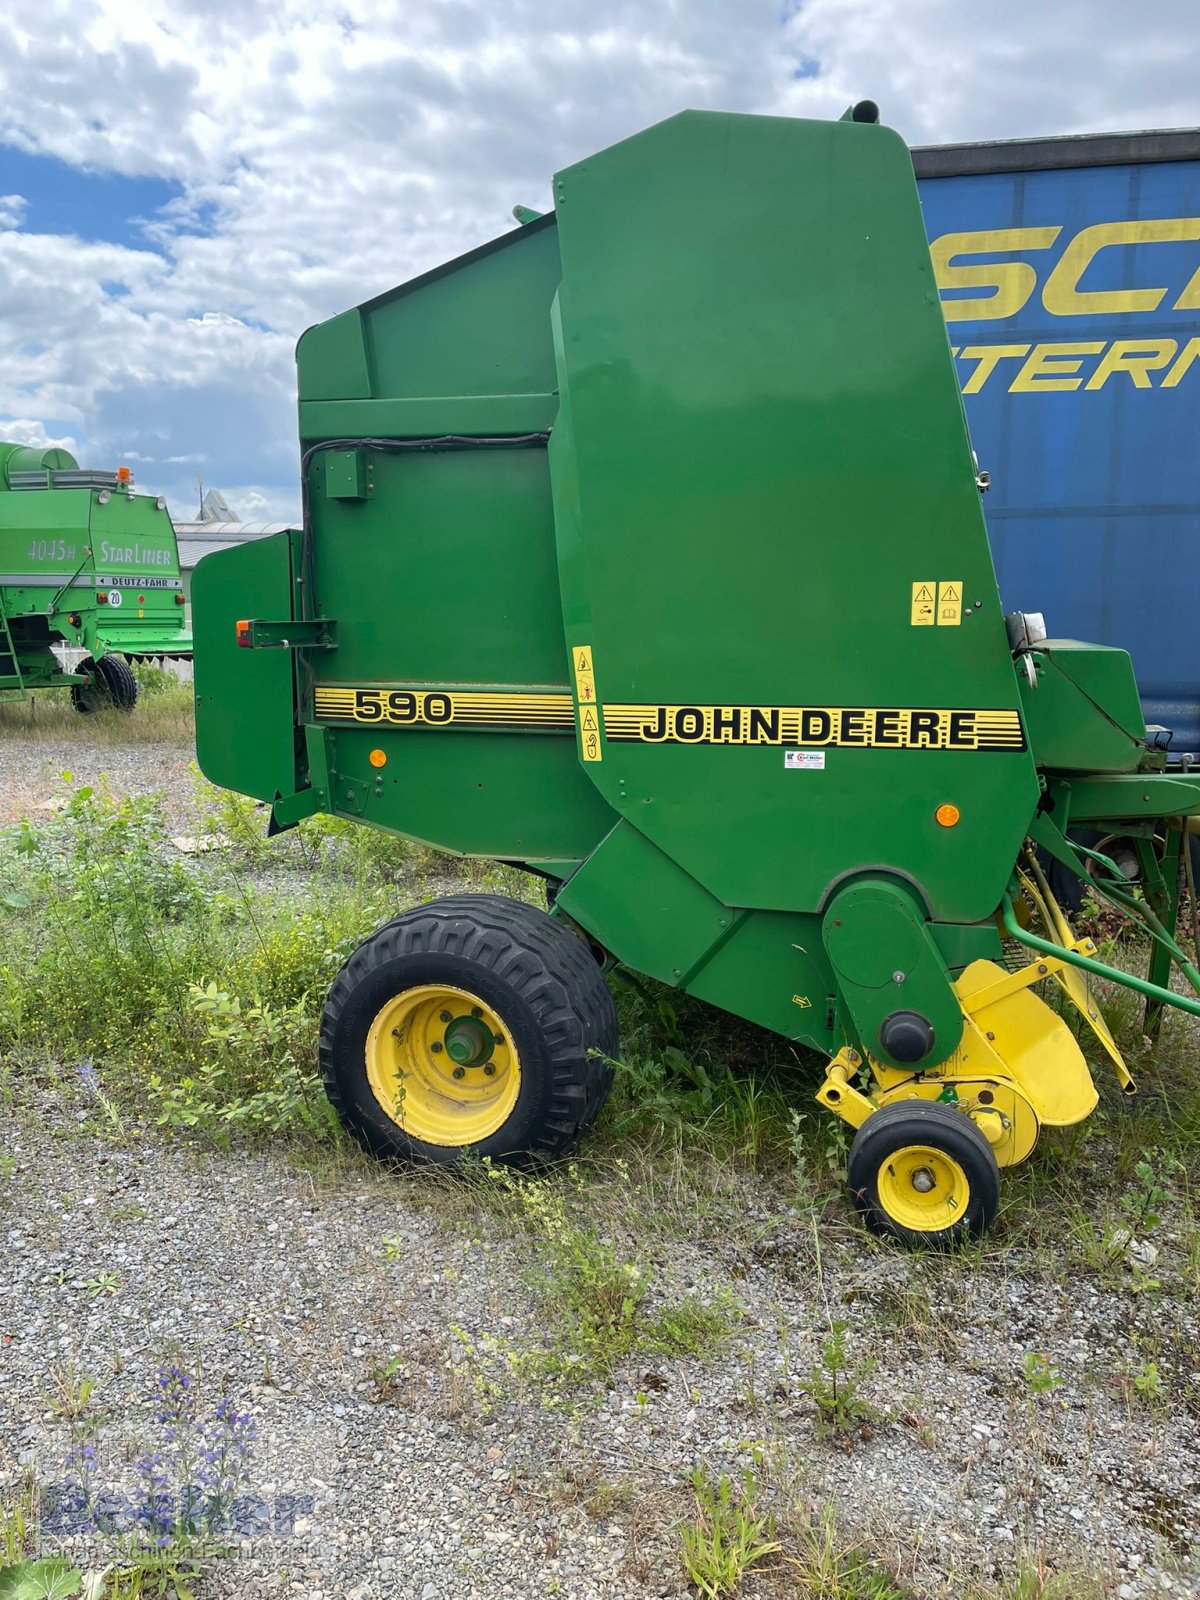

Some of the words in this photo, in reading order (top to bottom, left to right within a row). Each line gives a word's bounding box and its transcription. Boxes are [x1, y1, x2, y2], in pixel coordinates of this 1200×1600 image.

[929, 217, 1200, 322] SC
[951, 337, 1200, 394] TER
[28, 539, 76, 561] 4045H
[112, 577, 168, 588] DEUTZ-FAHR
[111, 592, 120, 606] 20
[354, 691, 453, 723] 590
[641, 706, 781, 743] JOHN
[799, 709, 978, 748] DEERE
